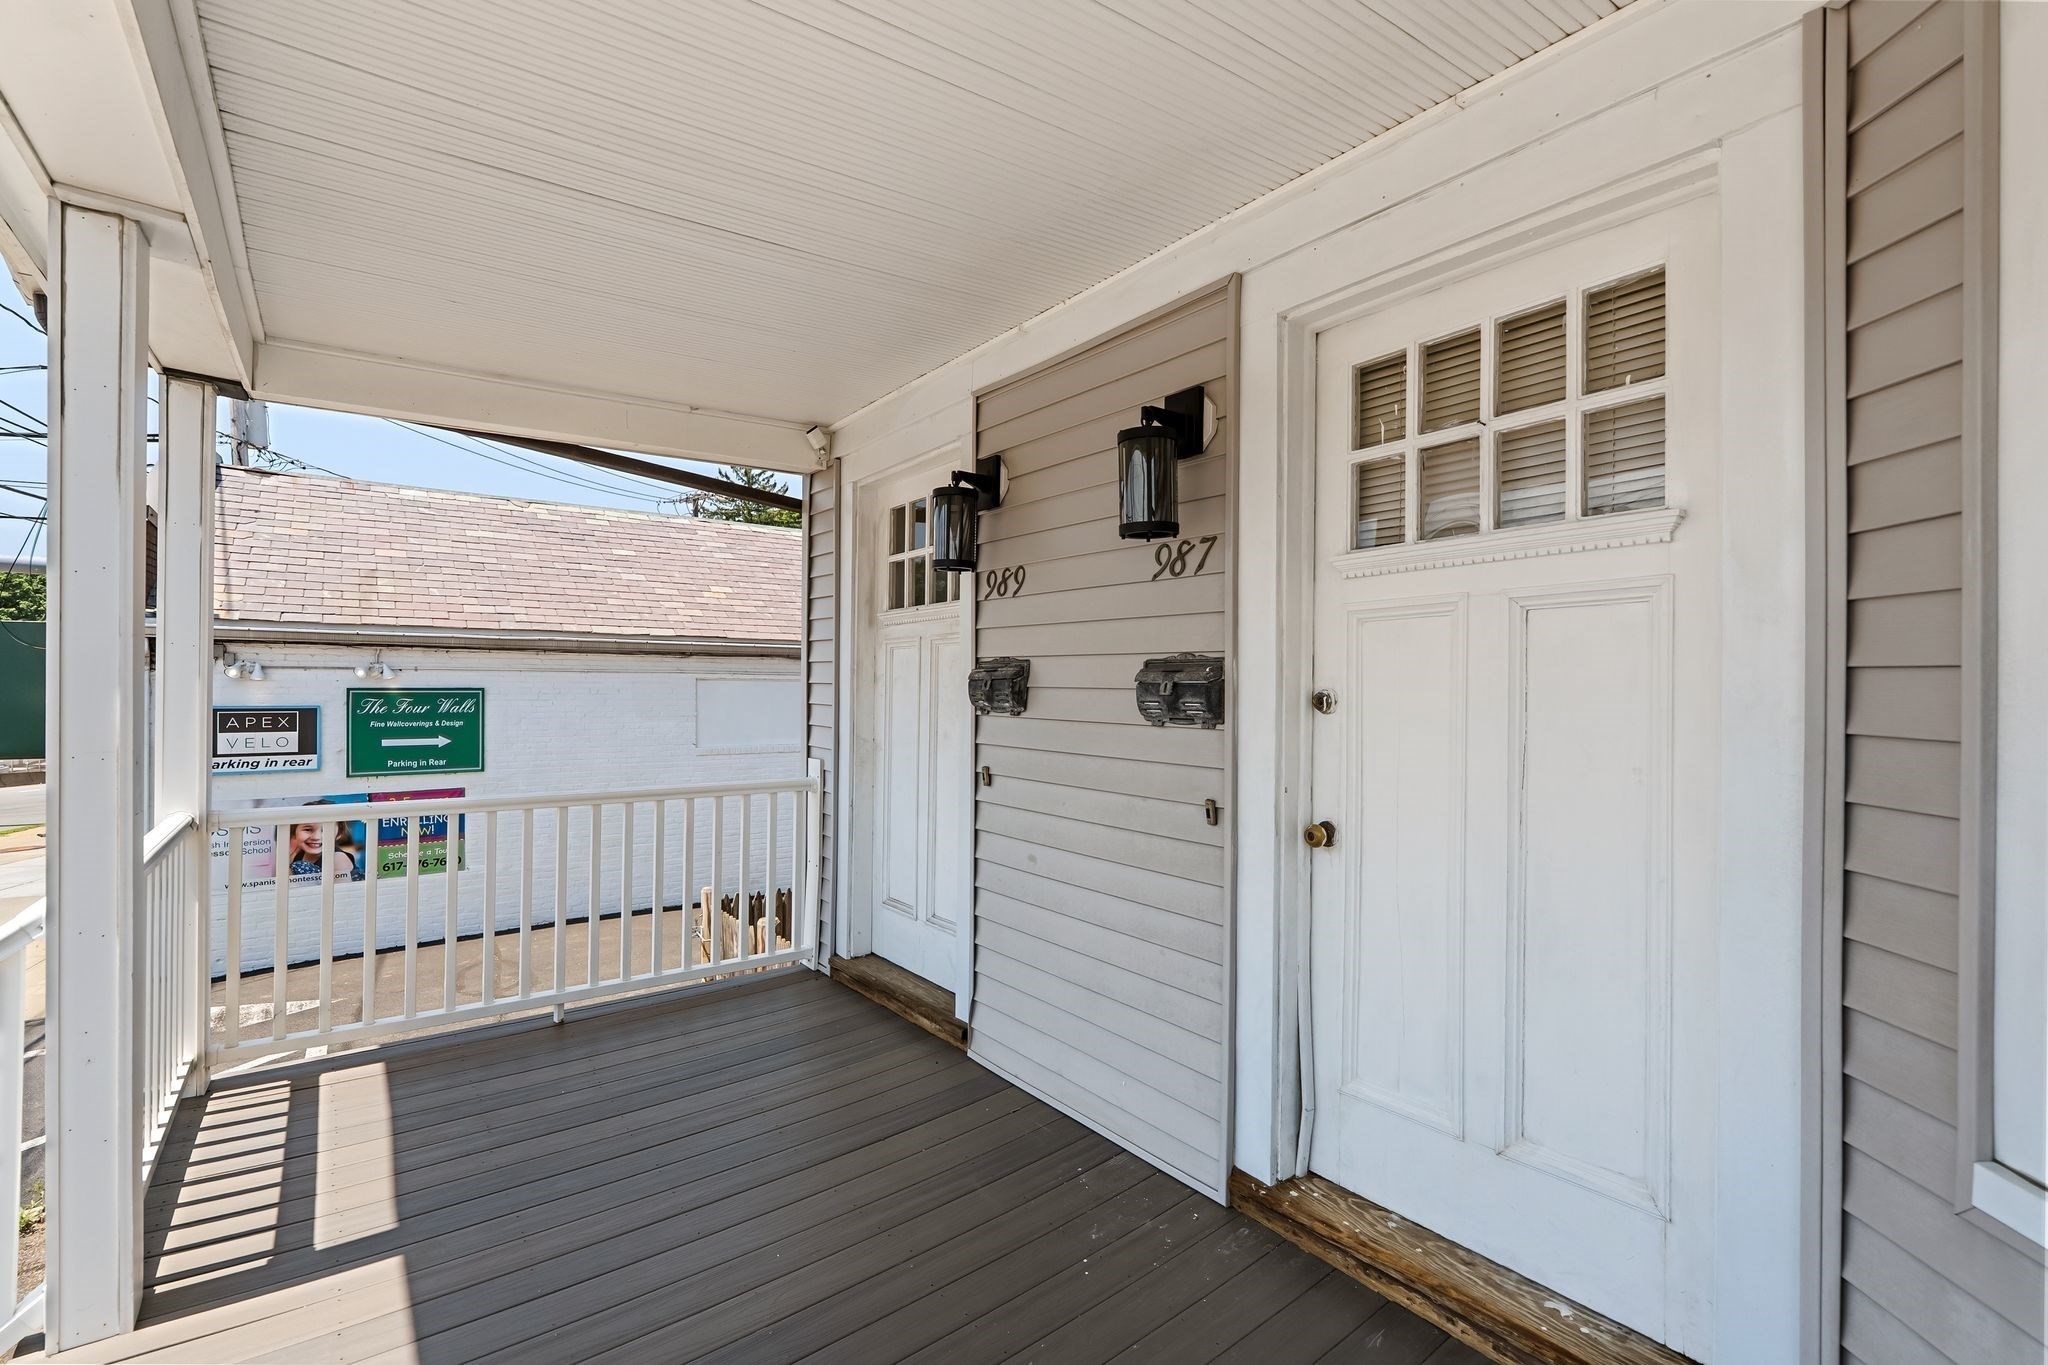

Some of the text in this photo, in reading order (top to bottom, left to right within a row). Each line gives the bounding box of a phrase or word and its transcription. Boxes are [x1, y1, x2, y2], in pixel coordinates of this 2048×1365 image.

[1152, 536, 1218, 582] 987
[985, 565, 1026, 601] 989
[356, 697, 477, 715] The Four Walls
[226, 716, 290, 728] APEX
[387, 720, 433, 728] Wallcoverings
[441, 720, 464, 728] Design
[226, 737, 289, 749] VELO
[212, 758, 313, 770] arking in rear
[388, 760, 417, 768] Parking
[401, 825, 435, 837] NW!
[242, 846, 272, 855] School
